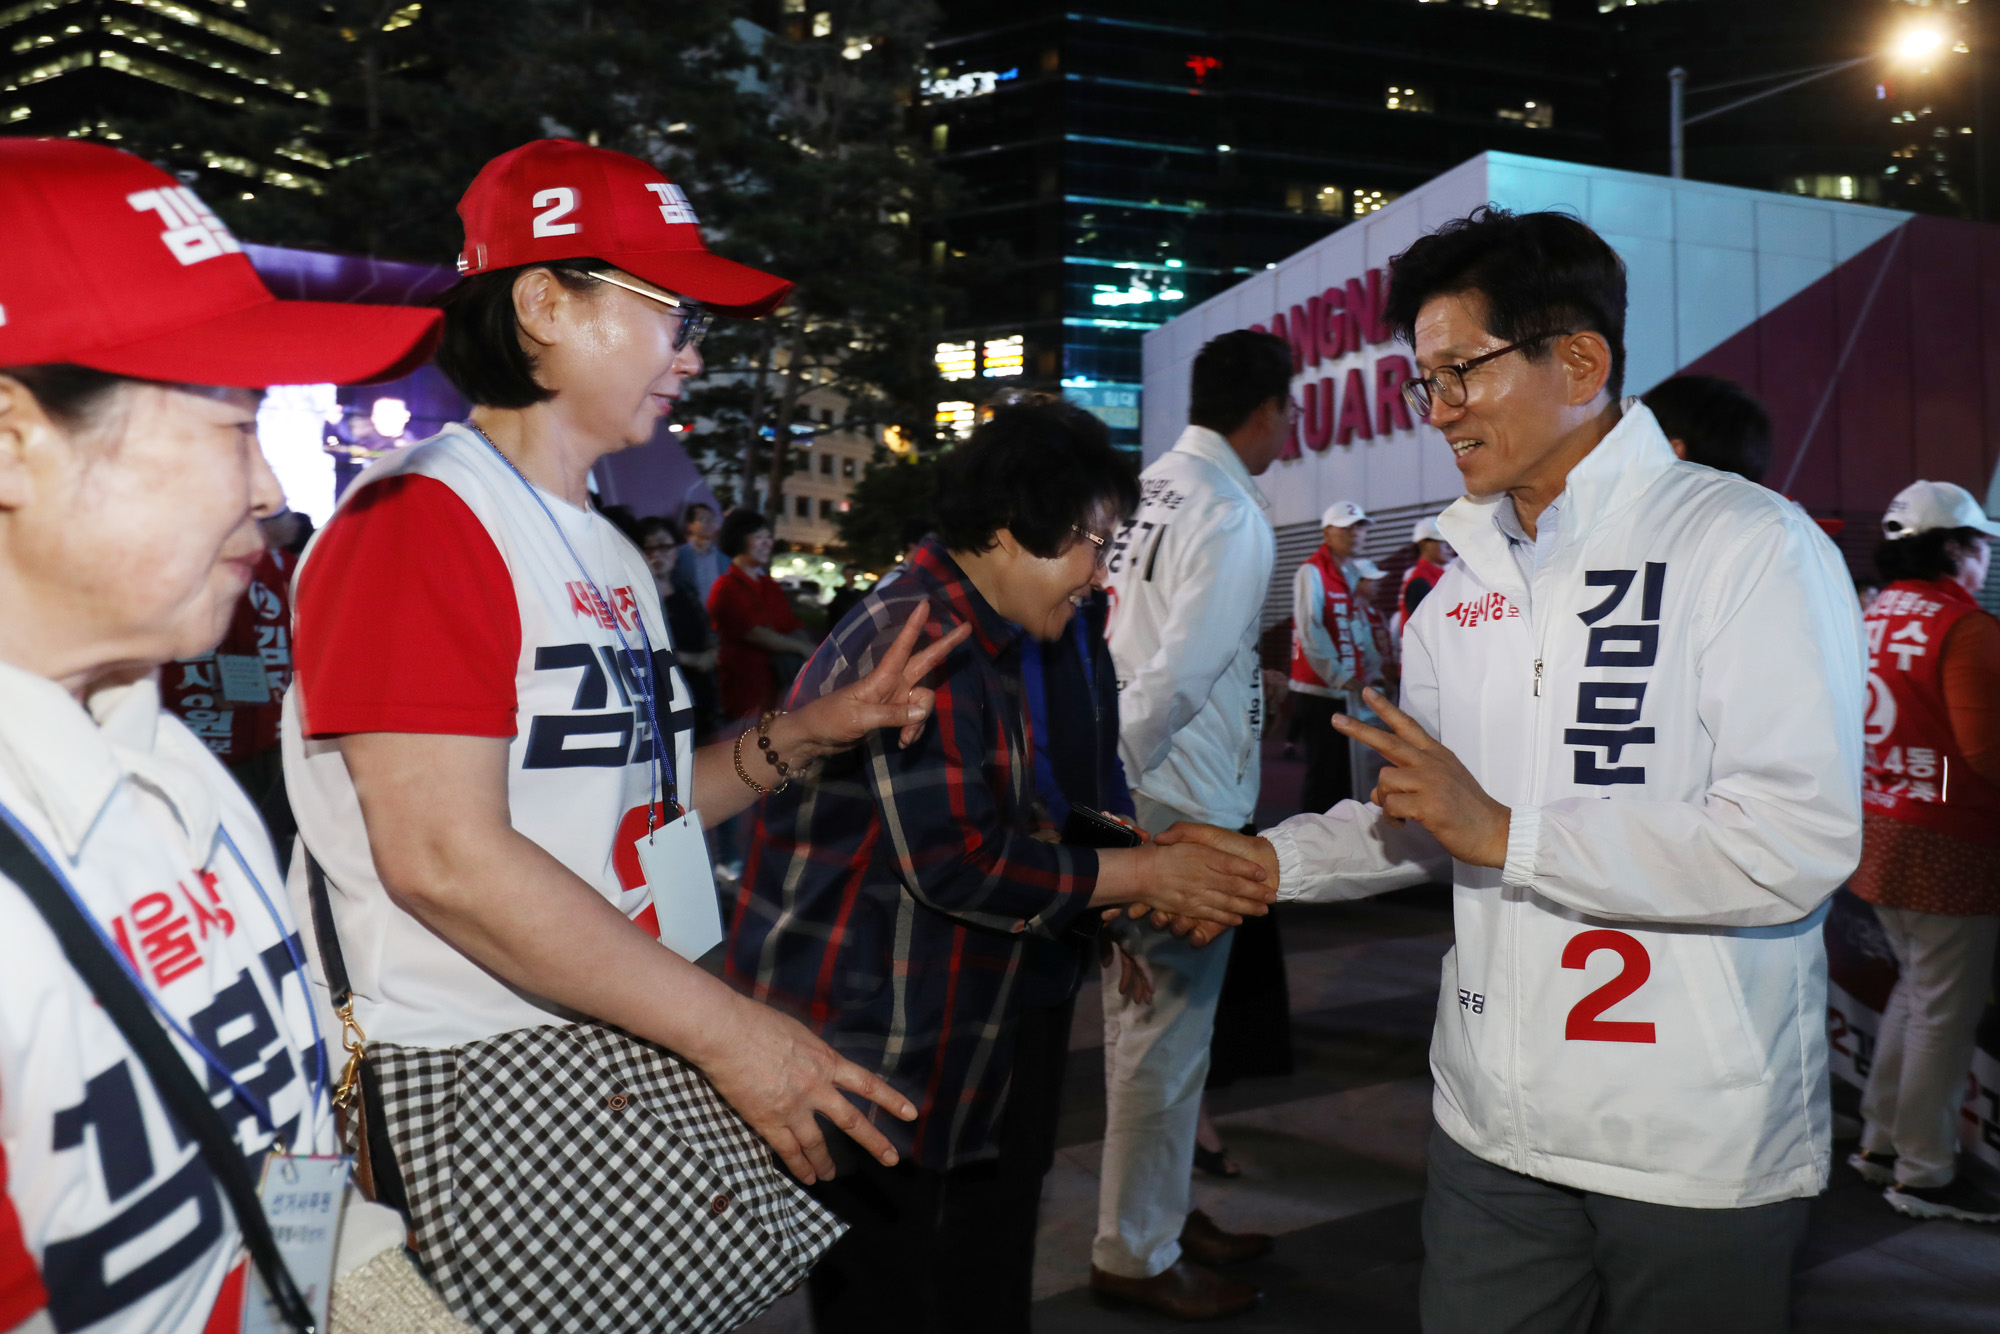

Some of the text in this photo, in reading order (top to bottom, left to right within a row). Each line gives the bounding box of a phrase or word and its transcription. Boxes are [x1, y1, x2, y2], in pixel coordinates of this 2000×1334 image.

[532, 186, 583, 239] 2
[1445, 591, 1507, 628] 서울시장
[1562, 561, 1668, 800] 김문
[1560, 929, 1657, 1044] 2
